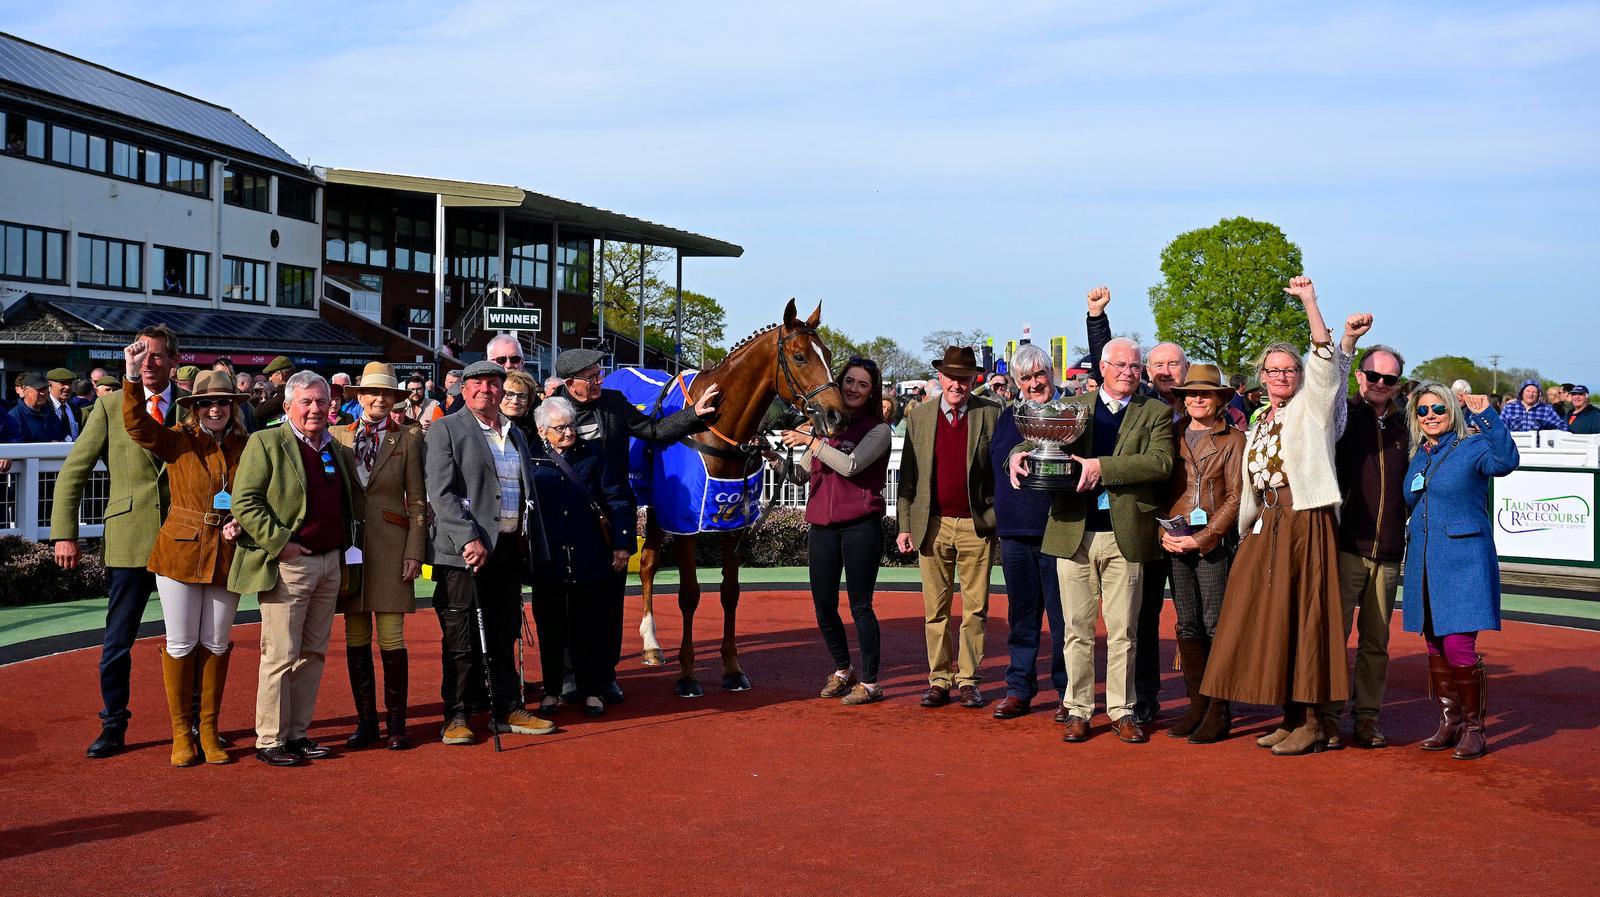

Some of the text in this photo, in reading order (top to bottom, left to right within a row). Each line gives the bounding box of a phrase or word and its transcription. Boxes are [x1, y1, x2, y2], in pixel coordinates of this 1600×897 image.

[490, 313, 539, 324] WINNER
[1502, 498, 1559, 512] TAUNTON
[1511, 510, 1586, 526] RACECOURSE
